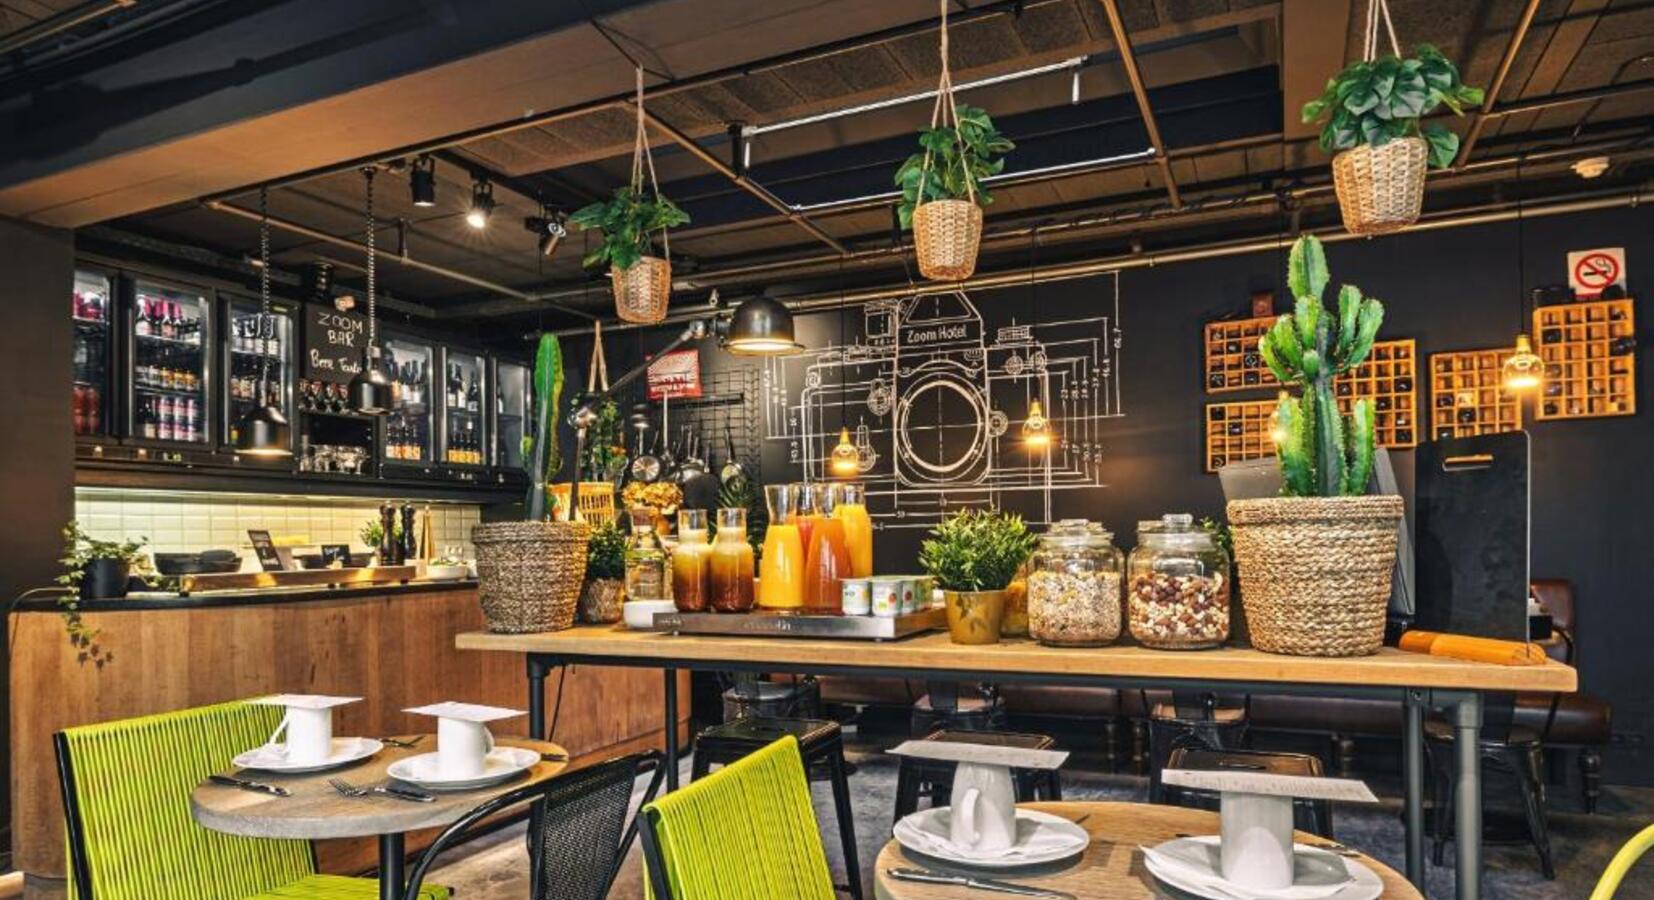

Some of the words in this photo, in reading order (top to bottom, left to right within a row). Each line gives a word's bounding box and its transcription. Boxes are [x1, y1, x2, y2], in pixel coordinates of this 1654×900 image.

[318, 312, 363, 334] ZOOM
[327, 330, 354, 347] BAR
[907, 328, 938, 343] Zoom
[938, 324, 967, 339] Hotel
